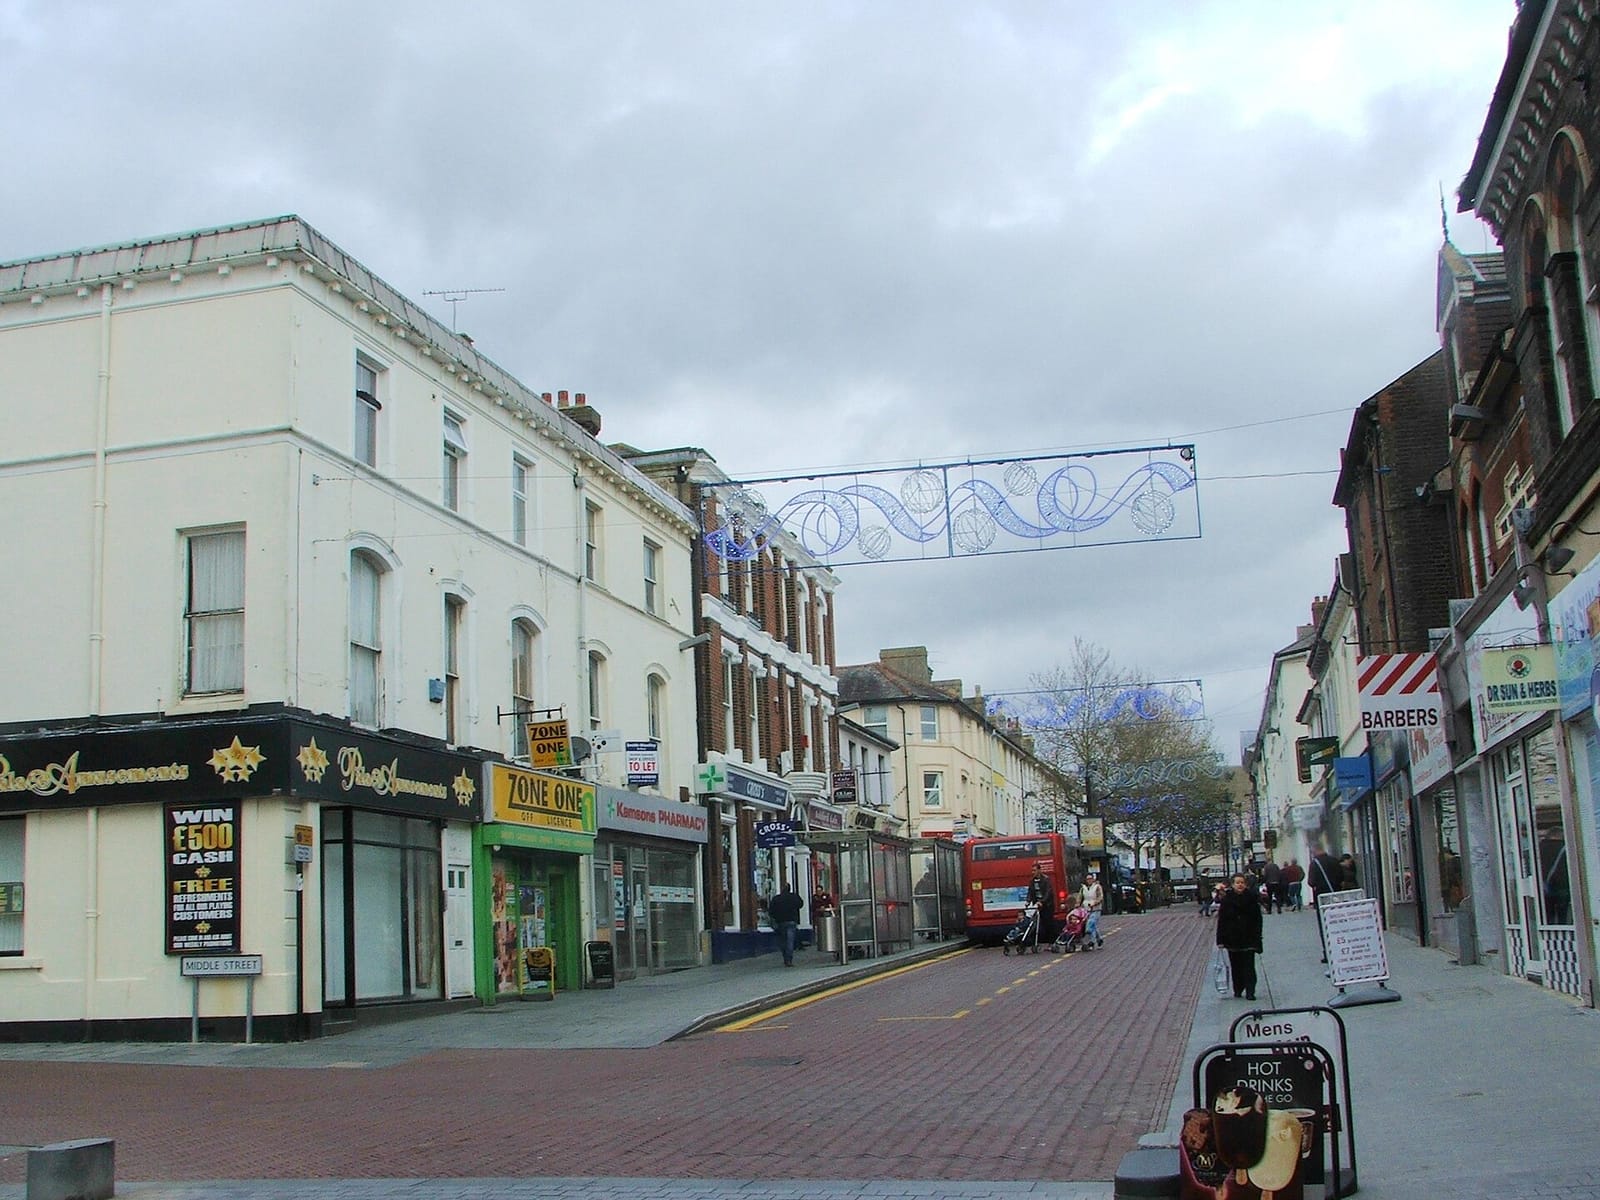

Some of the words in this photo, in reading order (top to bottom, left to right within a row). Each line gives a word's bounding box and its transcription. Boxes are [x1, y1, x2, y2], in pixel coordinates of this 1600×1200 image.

[1487, 685, 1500, 702] DR
[1500, 684, 1518, 700] SUN
[1520, 683, 1526, 698] &
[1528, 680, 1557, 698] HERBS
[1362, 708, 1438, 728] BARBERS
[530, 724, 568, 740] ZONE
[536, 742, 564, 754] ONE
[630, 762, 640, 771] TO
[643, 762, 656, 771] LET
[508, 773, 548, 808] ZONE
[554, 783, 582, 812] ONE
[172, 808, 233, 824] WIN
[520, 812, 534, 822] OFF
[546, 816, 572, 828] LICENCE
[658, 810, 706, 832] PHARMACY
[172, 823, 233, 851] £500
[173, 850, 233, 864] CASH
[173, 878, 233, 892] FREE
[173, 910, 233, 920] CUSTOMERS
[186, 961, 219, 971] MIDDLE
[224, 959, 257, 970] STREET
[1246, 1024, 1293, 1038] Mens
[1248, 1062, 1282, 1075] HOT
[1236, 1078, 1294, 1092] DRINKS
[1275, 1094, 1293, 1102] GO
